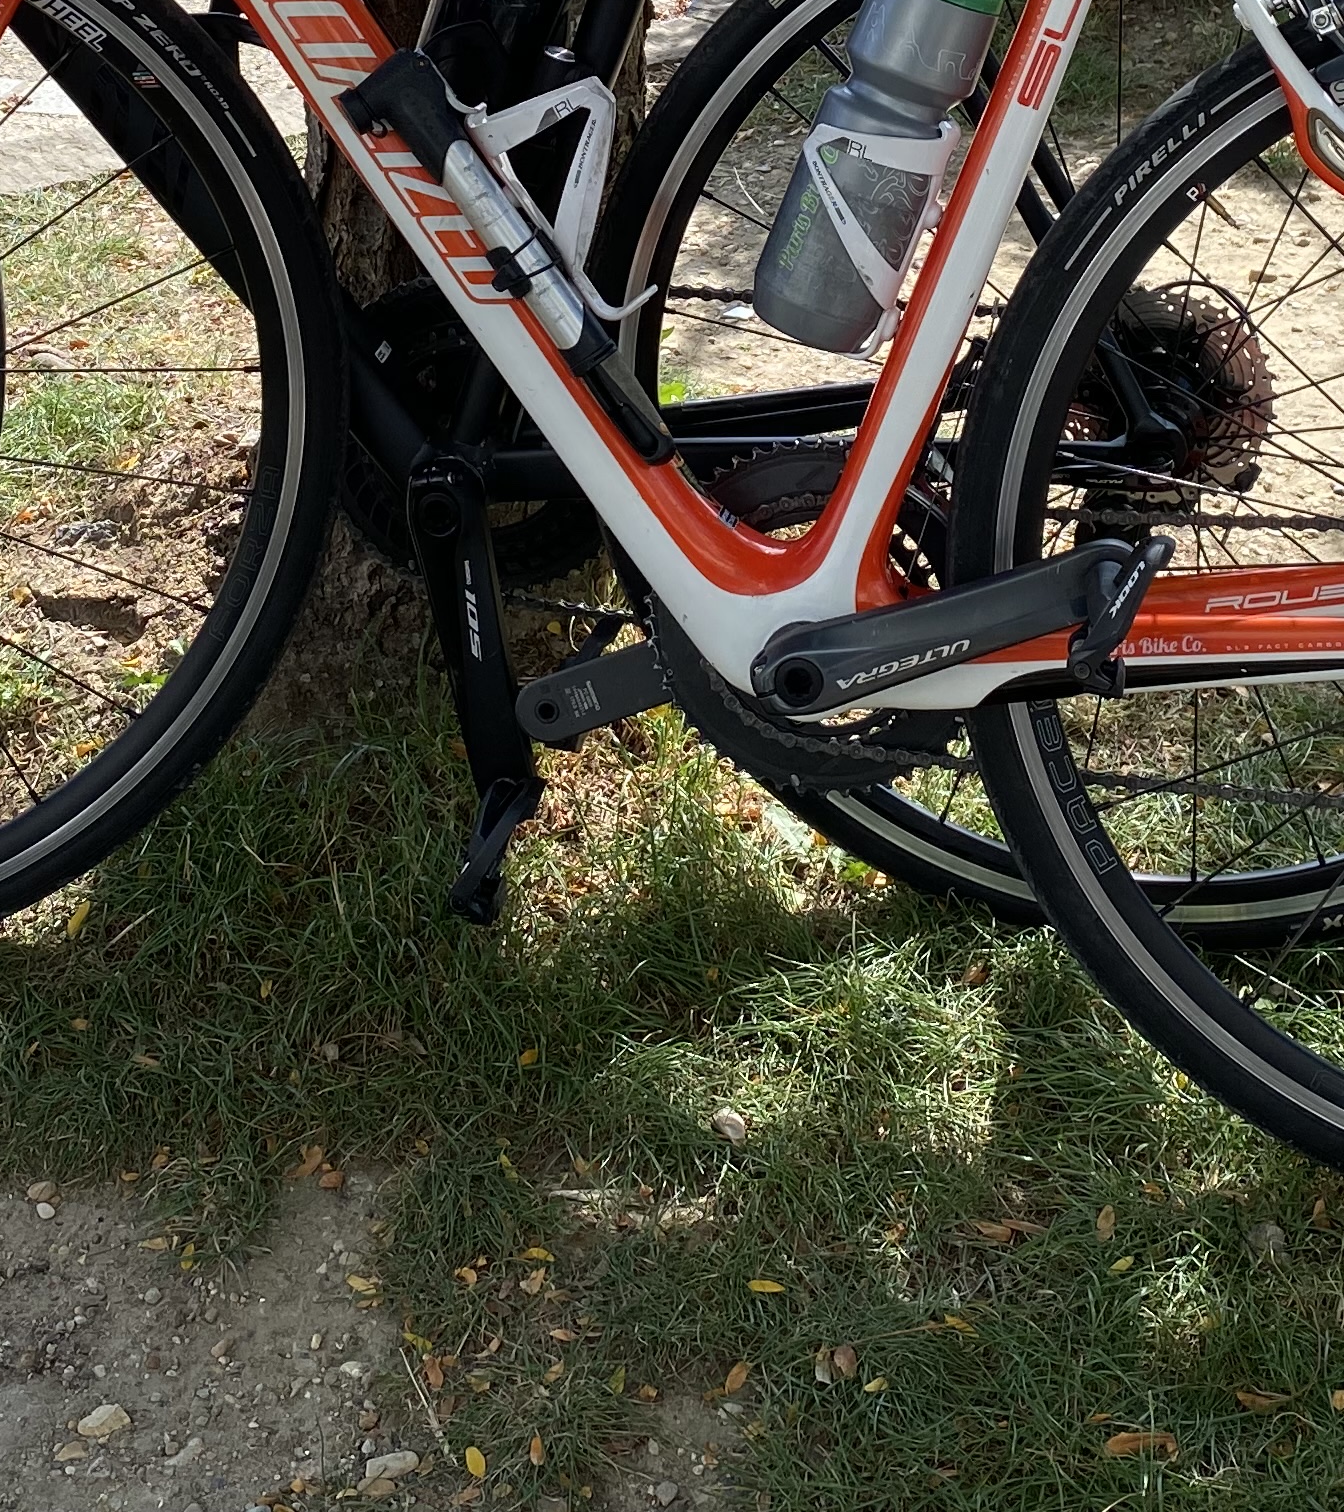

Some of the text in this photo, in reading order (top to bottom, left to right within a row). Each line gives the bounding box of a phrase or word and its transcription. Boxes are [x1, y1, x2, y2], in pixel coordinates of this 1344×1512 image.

[132, 13, 202, 77] ZERO
[1114, 111, 1206, 207] PIRELLI
[778, 182, 821, 272] Paris Bi
[1108, 560, 1147, 620] LOOK
[465, 588, 483, 662] 105
[1138, 637, 1178, 654] Bike
[1181, 635, 1208, 653] Co.
[1257, 642, 1290, 651] FACT
[836, 639, 972, 691] ULTEGRA
[1029, 698, 1119, 876] PACE
